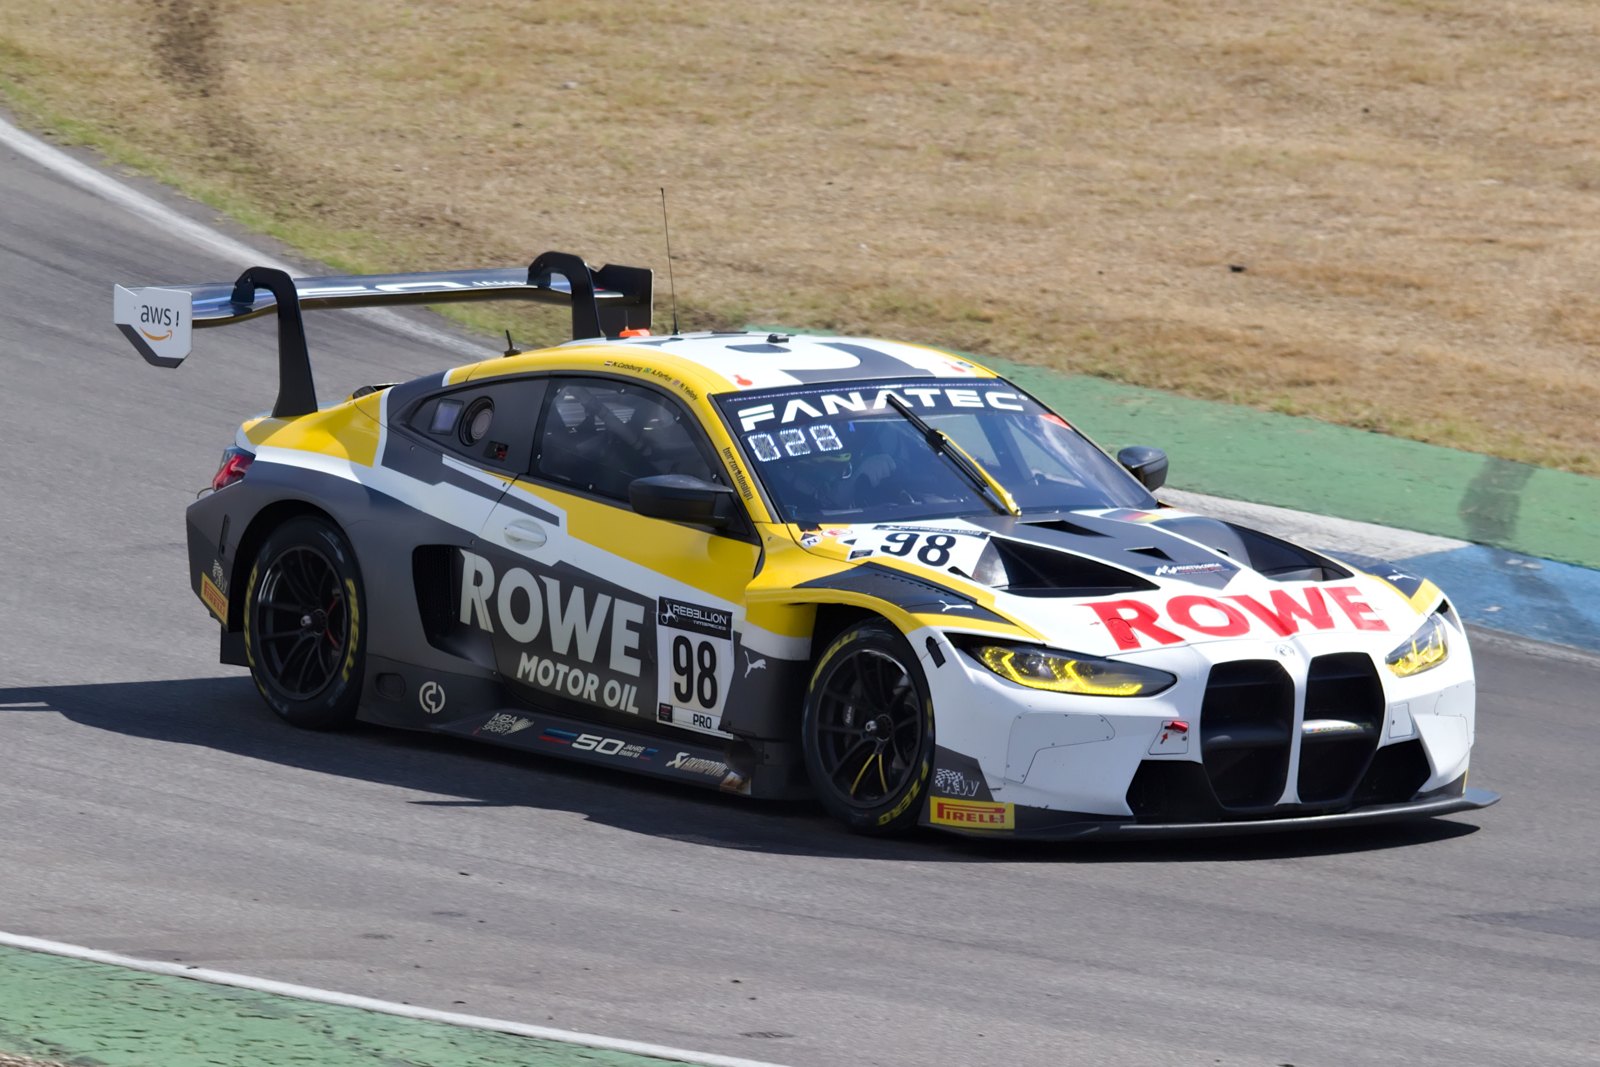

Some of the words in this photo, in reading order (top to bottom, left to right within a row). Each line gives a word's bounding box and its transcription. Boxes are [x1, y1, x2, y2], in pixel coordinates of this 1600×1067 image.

[140, 304, 172, 327] aws
[738, 389, 1024, 432] FANATEC
[880, 532, 956, 567] 98
[459, 548, 645, 678] ROWE
[672, 604, 727, 625] REBELLION
[1076, 586, 1391, 650] ROWE
[516, 652, 600, 703] MOTOR
[603, 680, 640, 715] OIL
[672, 635, 718, 709] 98
[693, 713, 712, 729] PRO
[571, 733, 626, 755] 50
[936, 802, 1005, 824] PIRELLI
